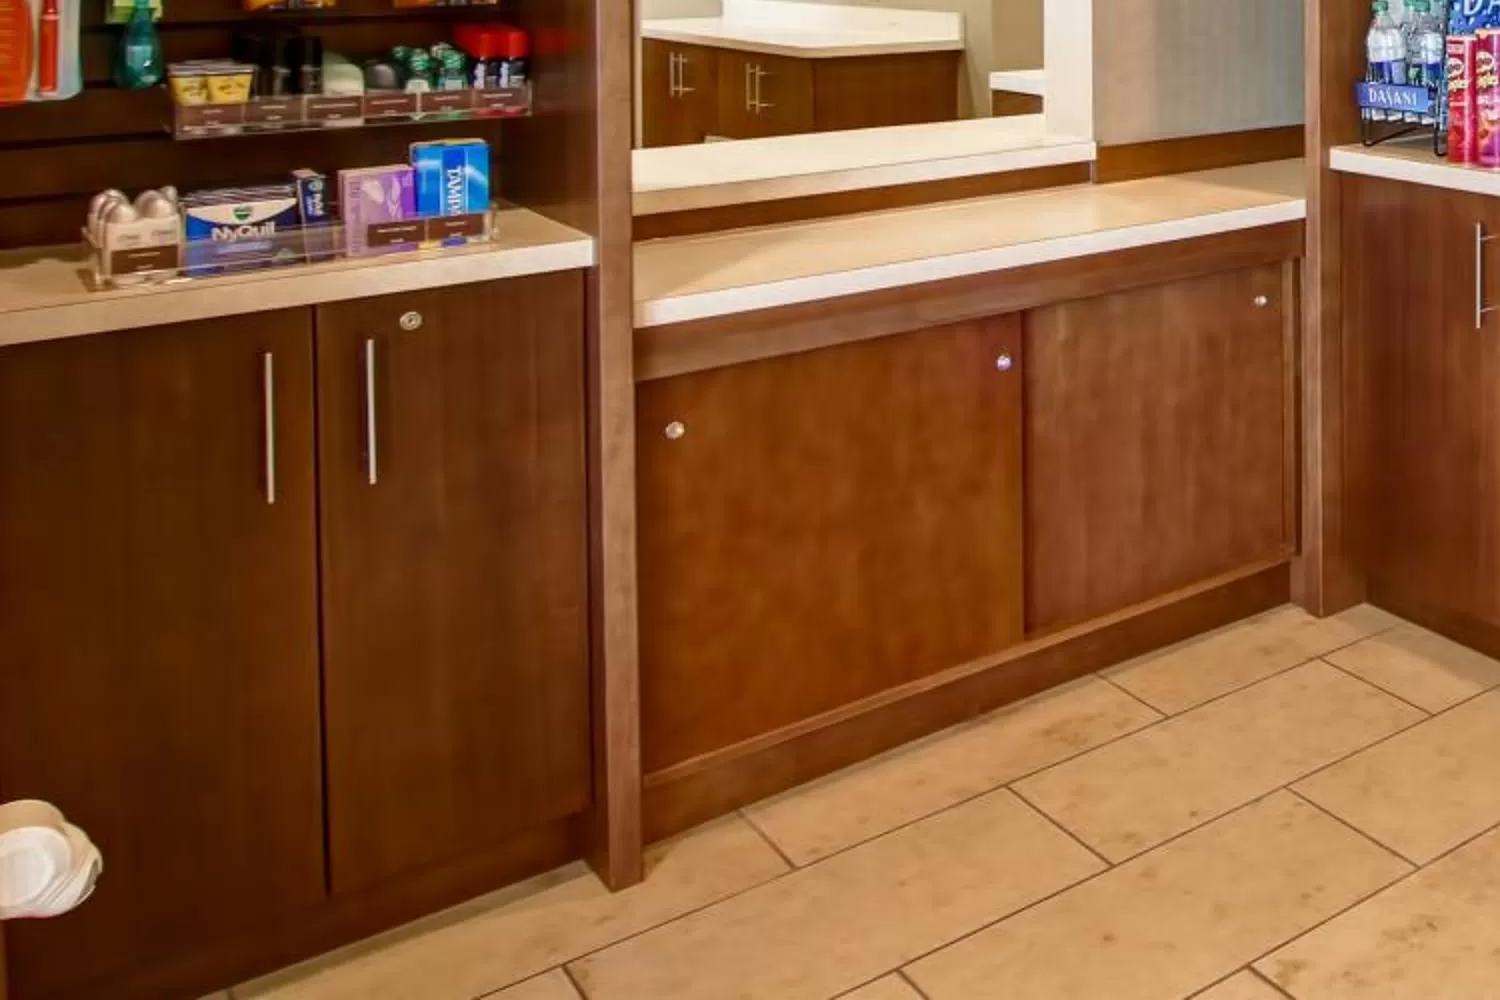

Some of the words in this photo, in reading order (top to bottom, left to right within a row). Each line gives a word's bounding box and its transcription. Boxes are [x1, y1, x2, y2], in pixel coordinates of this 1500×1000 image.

[1368, 85, 1418, 106] DASANI
[447, 166, 464, 216] TAMPA
[211, 221, 276, 242] NyQuil
